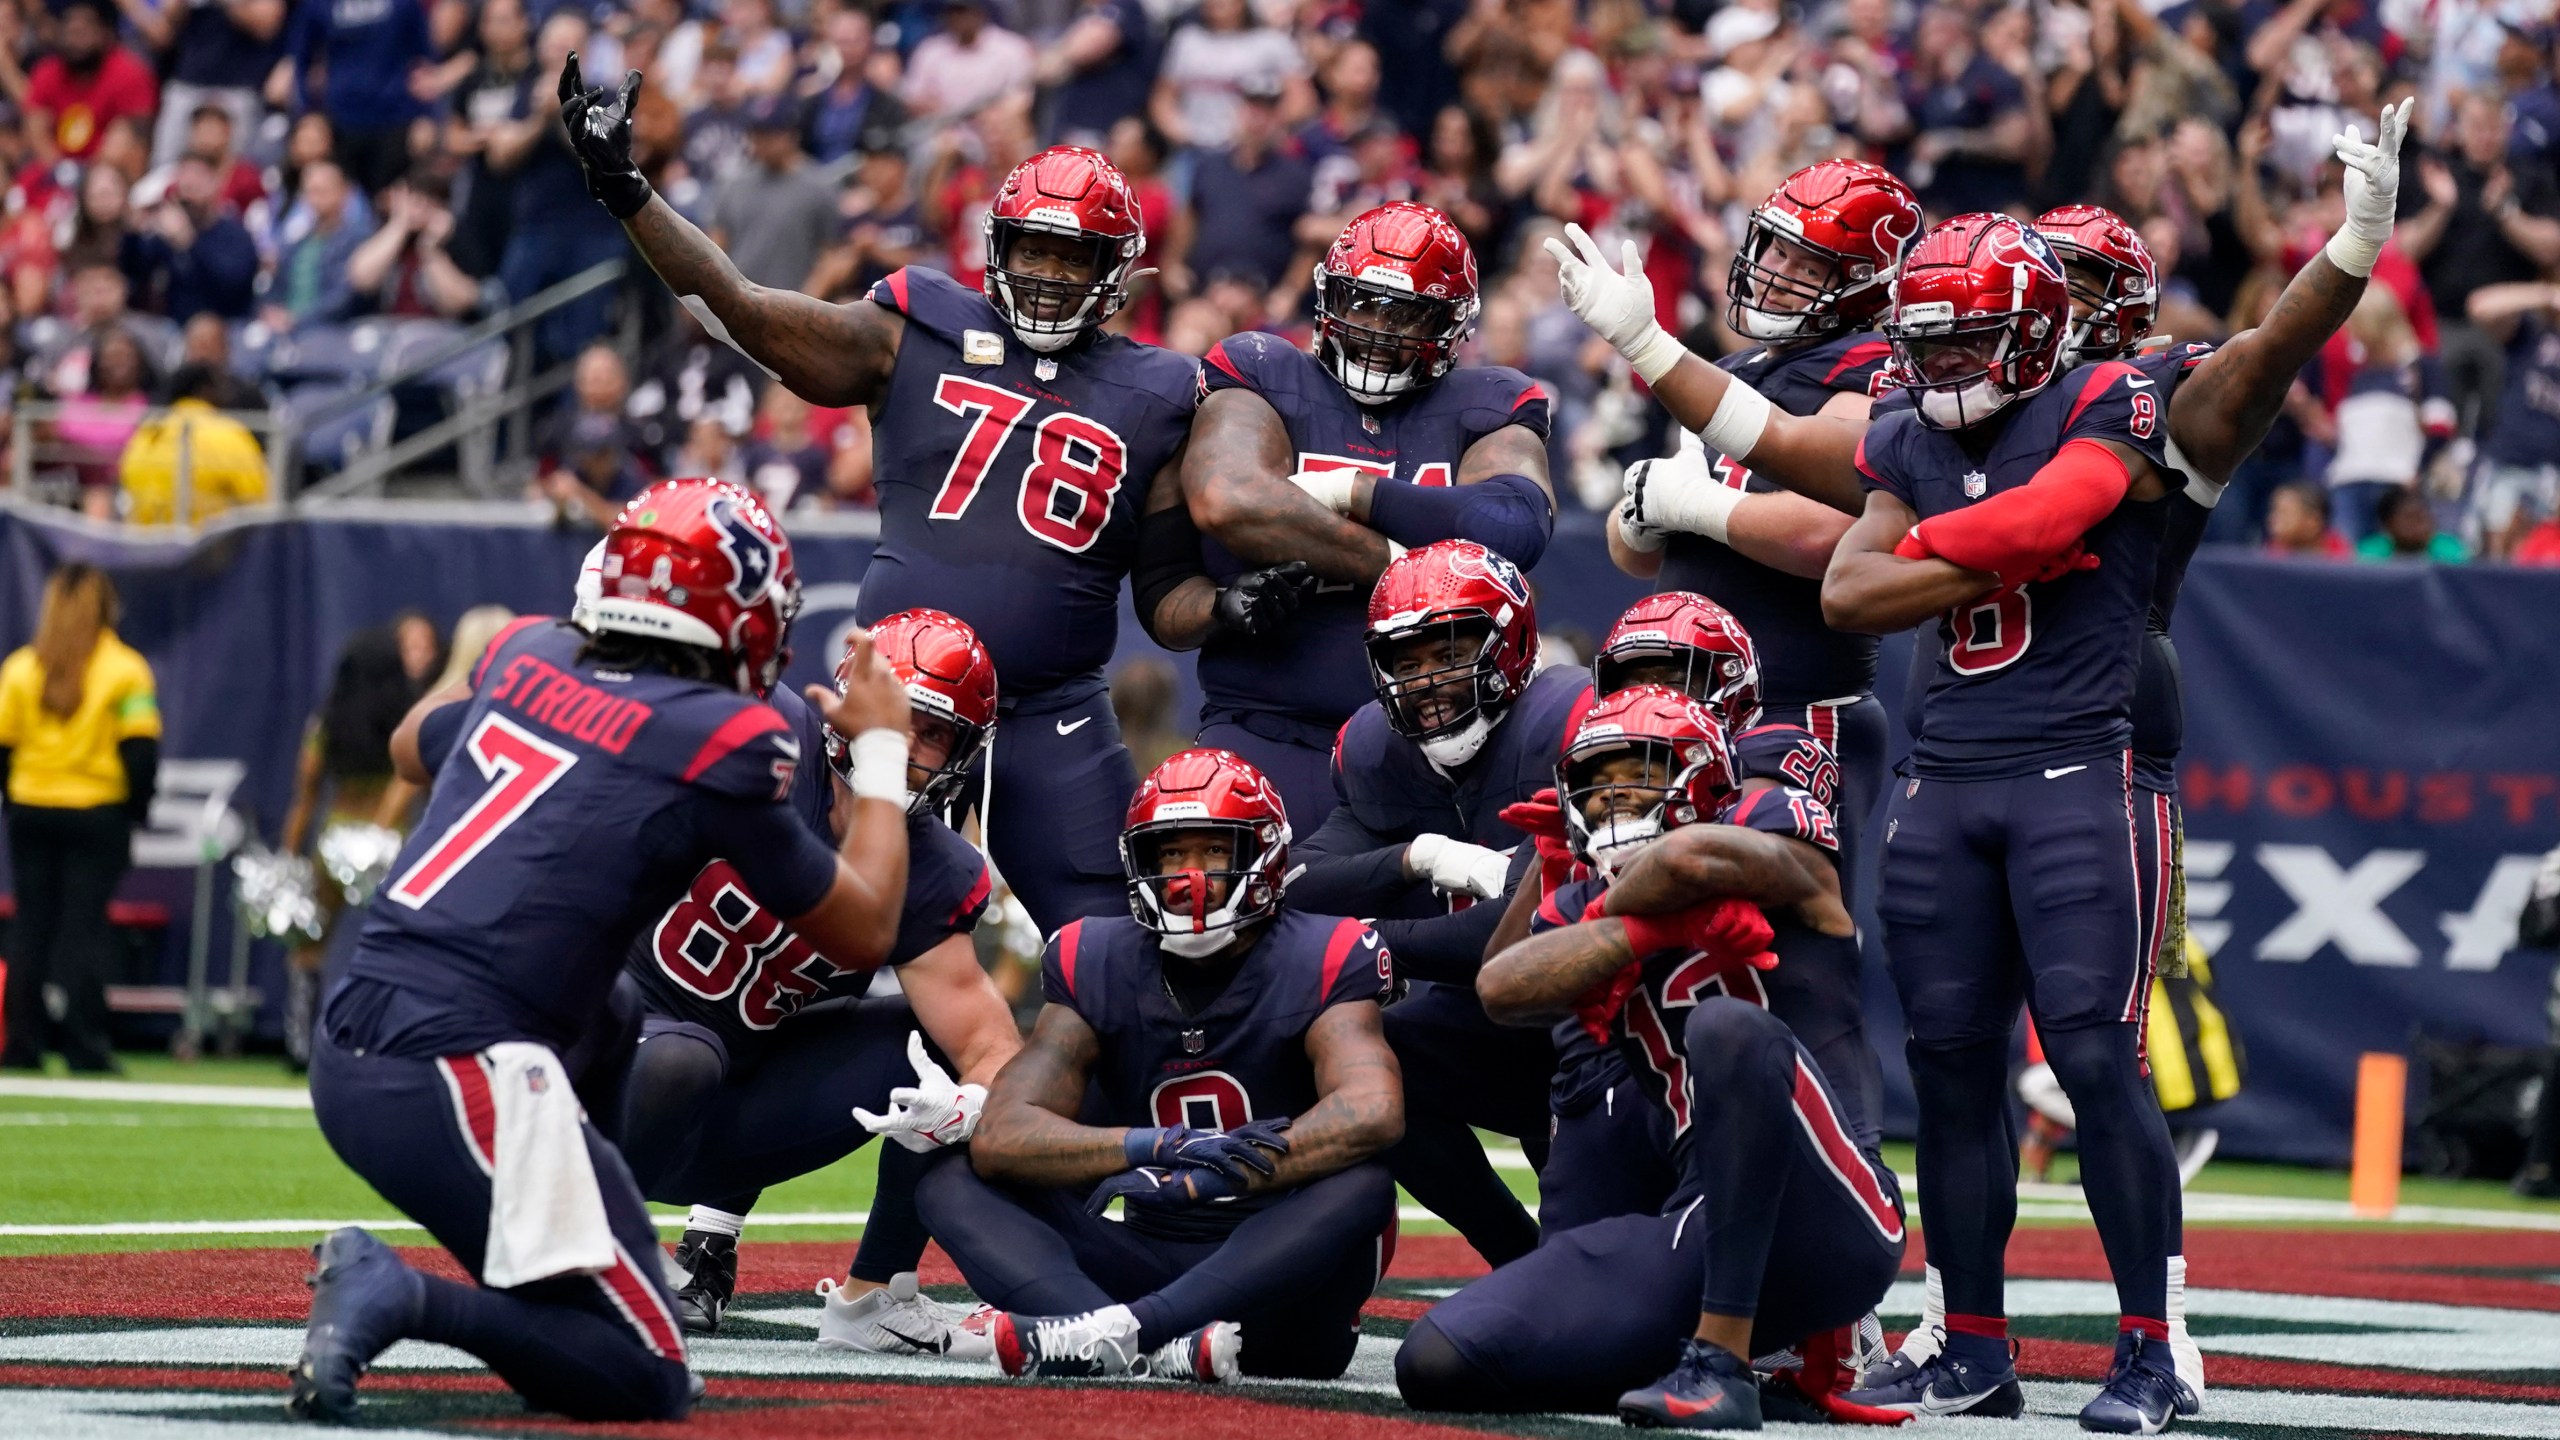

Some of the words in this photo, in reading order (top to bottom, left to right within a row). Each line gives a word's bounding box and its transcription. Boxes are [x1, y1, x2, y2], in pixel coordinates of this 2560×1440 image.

[1036, 211, 1071, 222] TEXANS
[1371, 269, 1405, 281] TEXANS
[1014, 381, 1072, 408] TEXANS
[2129, 391, 2157, 440] 8
[928, 373, 1128, 554] 78
[491, 652, 654, 755] STROUD
[913, 688, 948, 704] TEXANS
[769, 757, 798, 801] 7
[1779, 739, 1839, 807] 26
[2181, 762, 2559, 826] HOUST
[387, 710, 580, 912] 7
[1787, 797, 1839, 851] 12
[1377, 946, 1393, 994] 9
